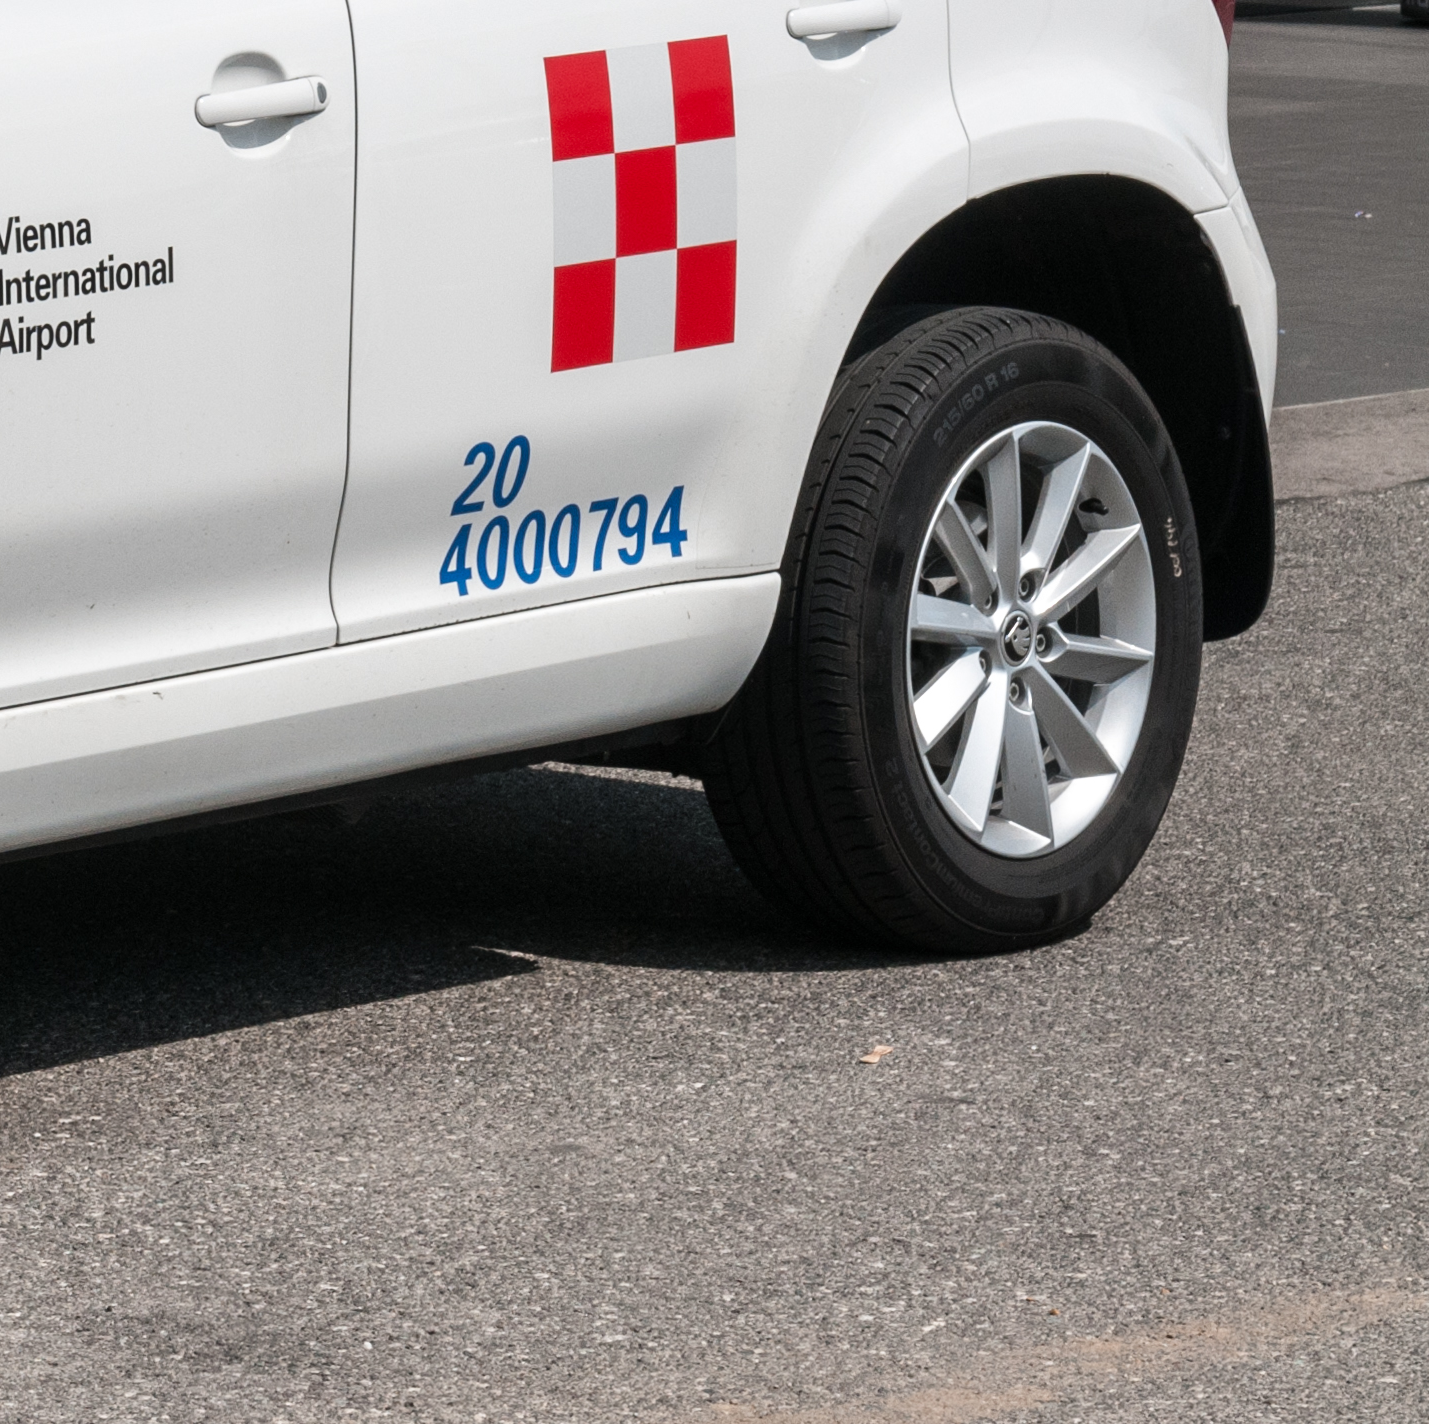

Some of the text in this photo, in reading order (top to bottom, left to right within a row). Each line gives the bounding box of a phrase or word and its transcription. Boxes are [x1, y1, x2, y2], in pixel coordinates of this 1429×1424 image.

[984, 372, 999, 392] R
[1000, 362, 1019, 381] 16
[450, 435, 531, 517] 20
[439, 485, 688, 597] 4000794
